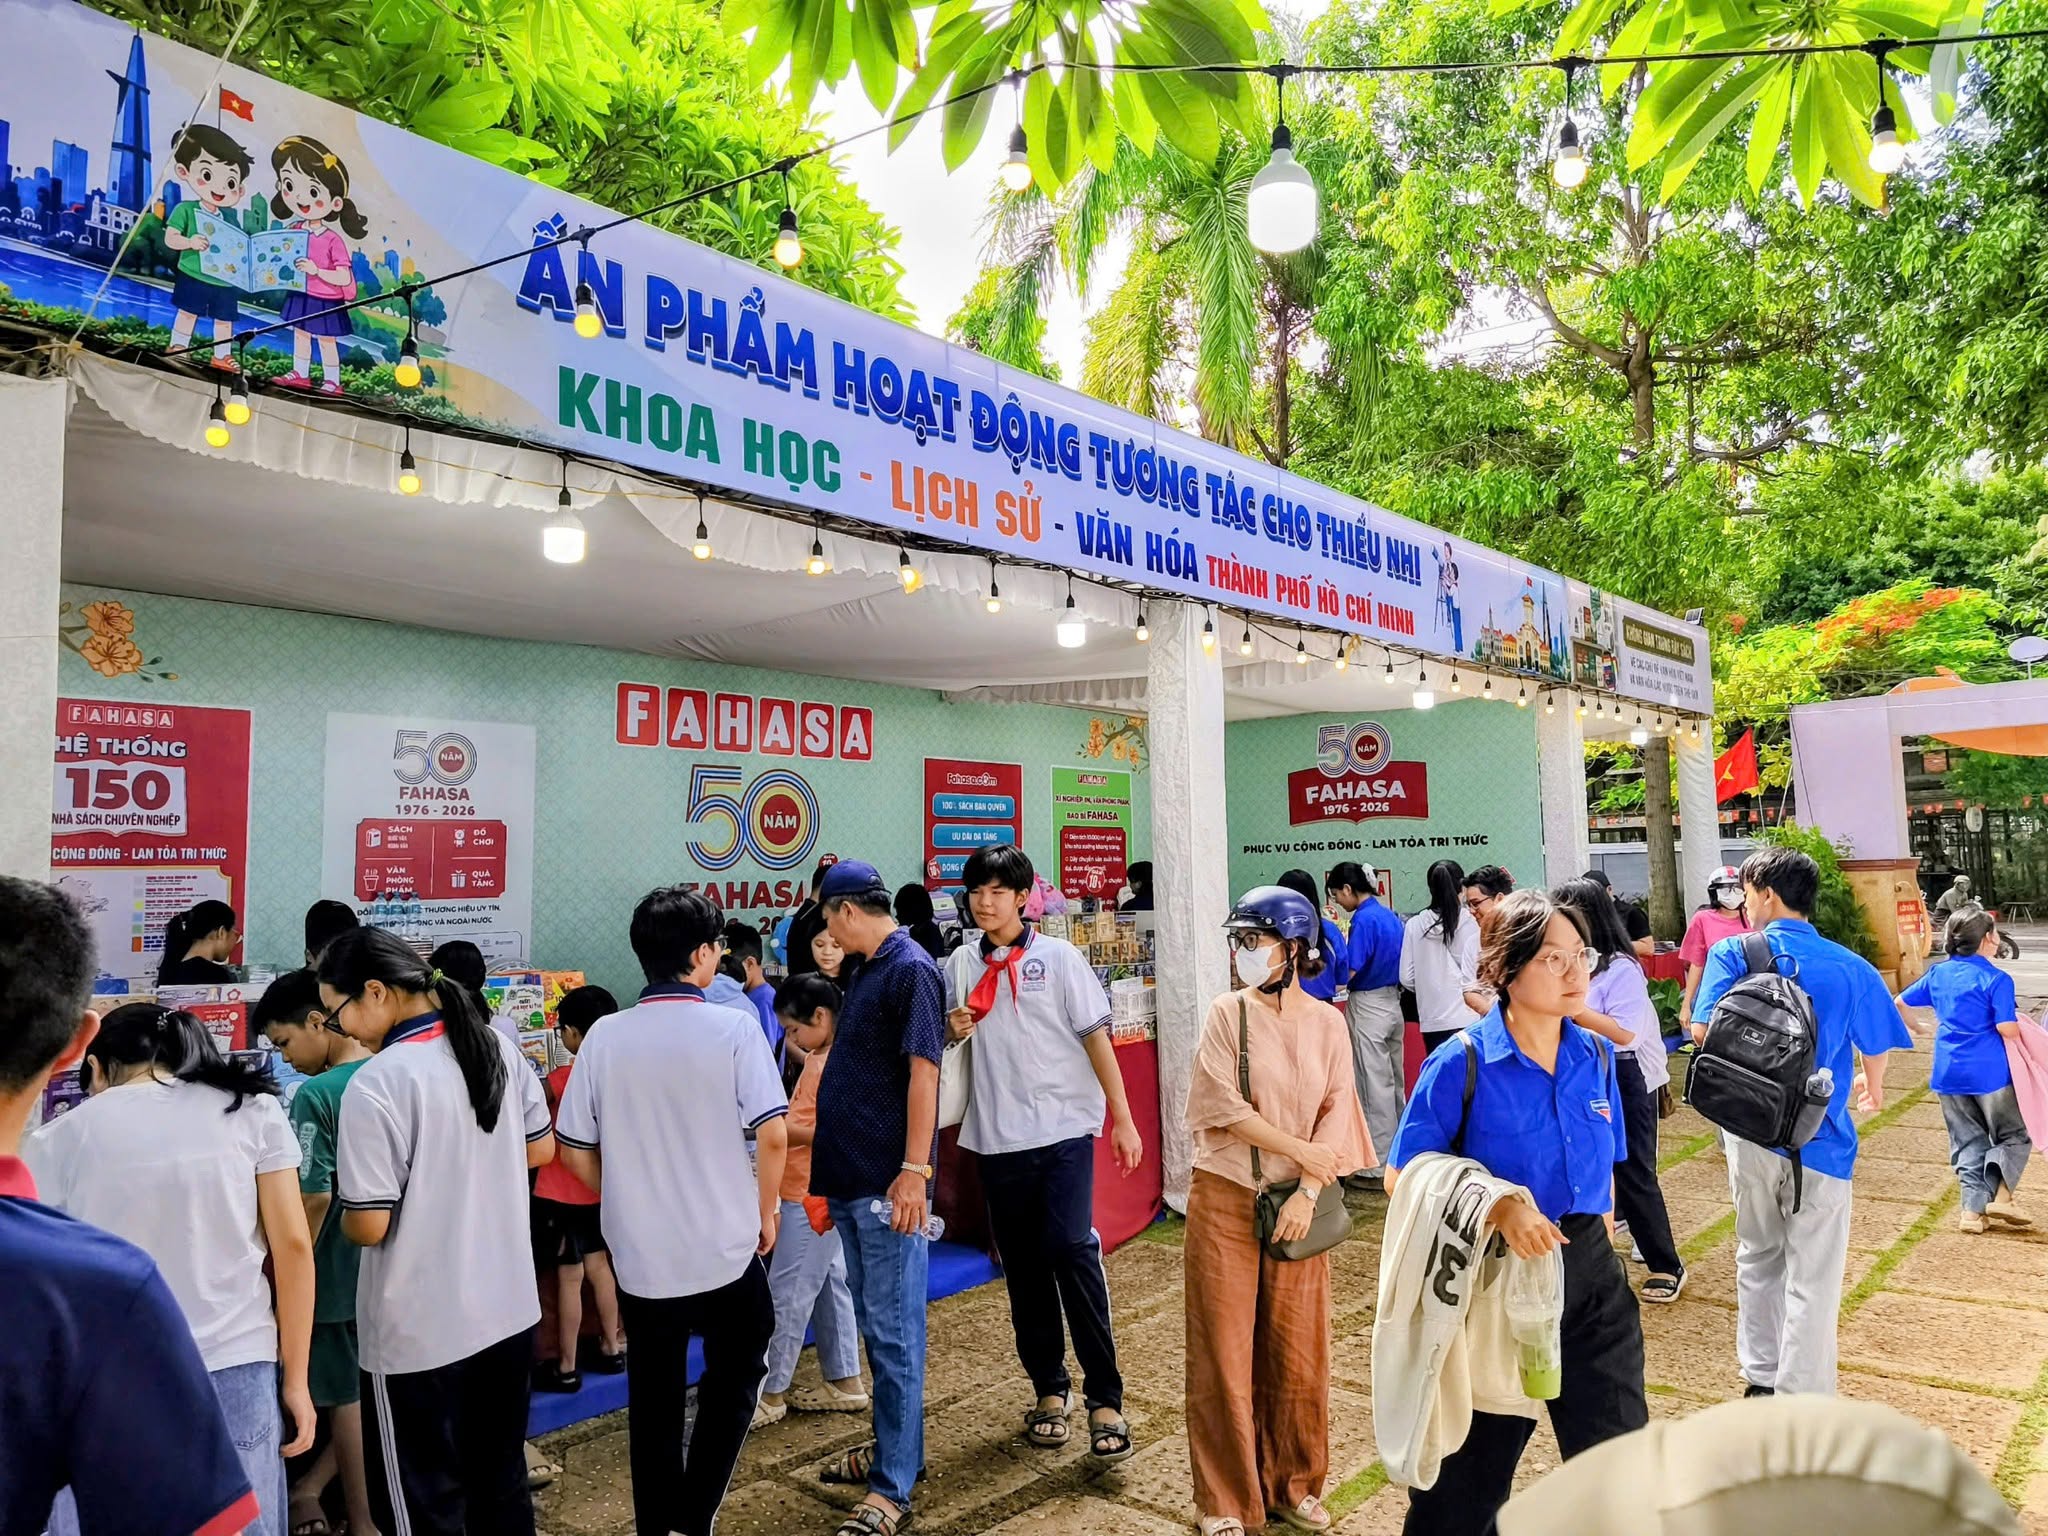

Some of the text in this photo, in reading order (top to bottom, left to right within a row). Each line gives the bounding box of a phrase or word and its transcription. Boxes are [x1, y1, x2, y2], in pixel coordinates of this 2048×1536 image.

[516, 212, 1422, 587] ẤN PHẨM HOẠT ĐỘNG TƯƠNG TÁC CHO THIẾU NHI
[558, 365, 721, 464] KHOA
[743, 417, 841, 493] HỌC
[890, 460, 978, 528] LỊCH
[995, 480, 1042, 543] SỬ
[1076, 507, 1133, 566] VĂN
[1146, 528, 1199, 582] HÓA
[1206, 552, 1415, 635] THÀNH PHỐ HỒ CHÍ MINH
[70, 706, 173, 727] FAHASA
[622, 687, 870, 757] FAHASA
[55, 732, 187, 758] HỆ THỐNG
[1317, 721, 1392, 778] 50
[1357, 744, 1376, 753] NĂM
[394, 730, 477, 786] 50
[441, 751, 462, 761] NĂM
[66, 768, 171, 810] 150
[400, 786, 470, 800] FAHASA
[1305, 780, 1406, 804] FAHASA
[395, 804, 429, 816] 1976
[442, 804, 475, 816] 2026
[686, 764, 820, 871] 50
[1087, 811, 1118, 820] FAHASA
[1323, 803, 1349, 815] 1976
[1360, 802, 1389, 813] 2026
[52, 811, 180, 828] NHÀ SÁCH CHUYÊN NGHIỆP
[388, 824, 413, 833] SÁCH
[763, 811, 797, 829] NĂM
[473, 838, 494, 846] CHƠI
[1243, 844, 1272, 855] PHỤC
[1275, 843, 1290, 854] VỤ
[1293, 840, 1324, 853] CỘNG
[1372, 839, 1396, 848] LAN
[1429, 837, 1449, 847] TRI
[1452, 834, 1488, 846] THỨC
[53, 845, 86, 862] CỘNG
[132, 848, 154, 860] LAN
[181, 848, 197, 859] TRI
[200, 845, 227, 860] THỨC
[425, 906, 456, 914] THƯƠNG
[458, 904, 475, 913] HIỆU
